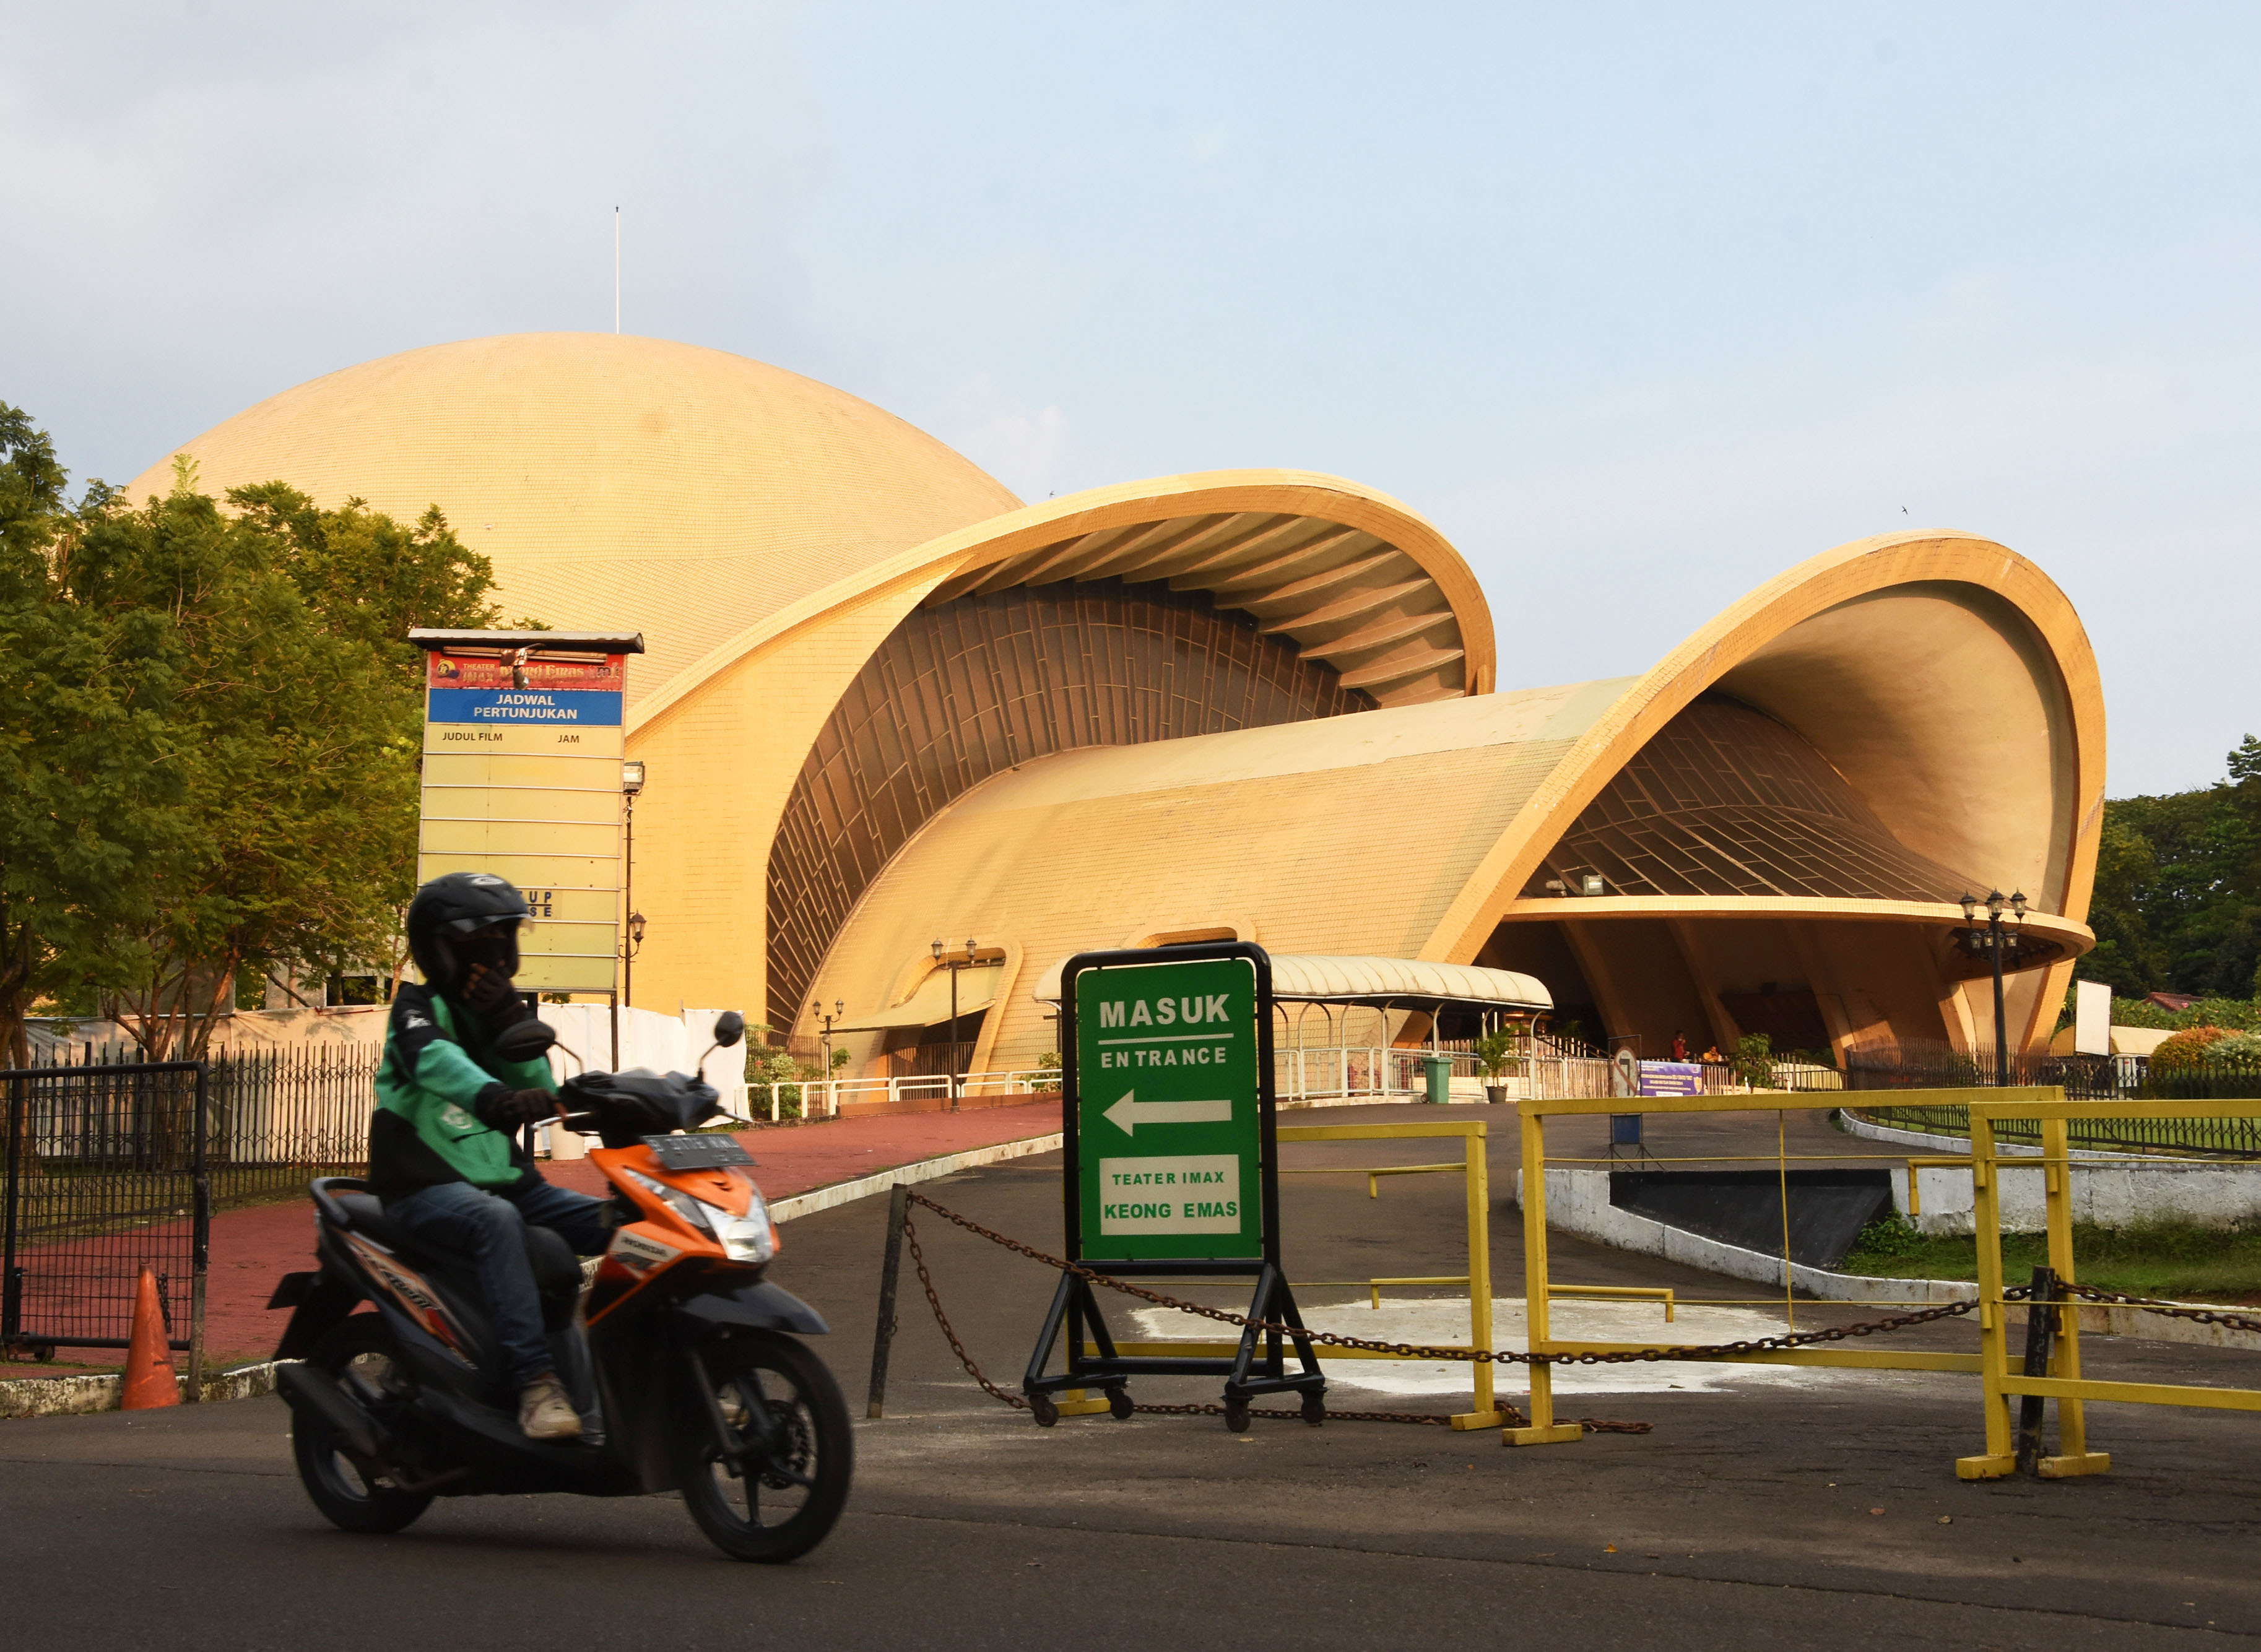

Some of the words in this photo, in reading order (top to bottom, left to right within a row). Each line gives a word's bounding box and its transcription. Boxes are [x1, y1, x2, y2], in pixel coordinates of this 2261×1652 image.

[496, 694, 555, 706] JADWAL
[474, 707, 578, 719] PERTUNJUKAN
[442, 732, 476, 741] JUDUL
[479, 733, 503, 742] FILM
[557, 735, 579, 743] JAM
[518, 891, 552, 903] UP
[529, 907, 552, 917] SE
[1100, 993, 1230, 1028] MASUK
[1101, 1047, 1226, 1068] ENTRANCE
[1112, 1172, 1176, 1186] TEATER
[1183, 1171, 1224, 1183] IMAX
[1104, 1203, 1172, 1219] KEONG
[1183, 1201, 1238, 1218] EMAS
